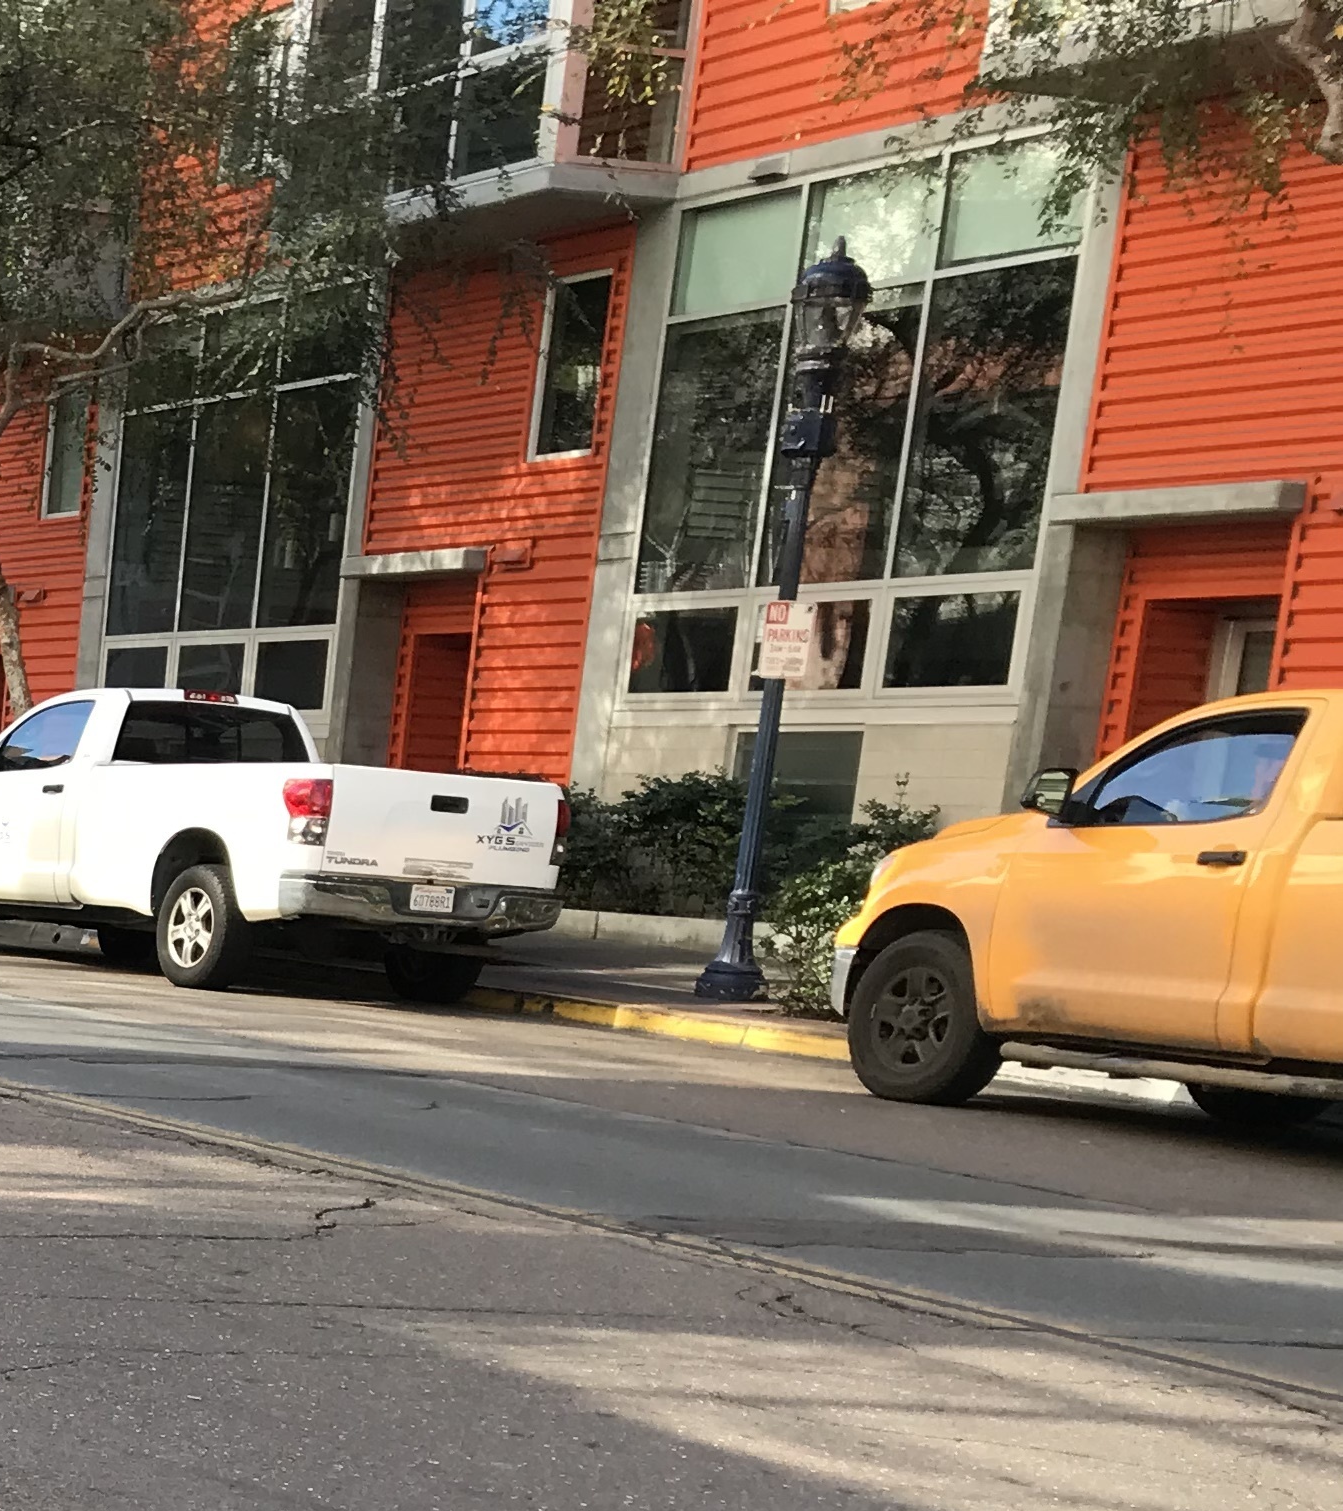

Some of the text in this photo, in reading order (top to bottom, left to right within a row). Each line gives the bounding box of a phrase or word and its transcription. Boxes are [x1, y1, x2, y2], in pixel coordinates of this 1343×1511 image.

[768, 604, 787, 621] NO
[767, 629, 810, 642] PARKING
[326, 856, 378, 866] TUNDRA
